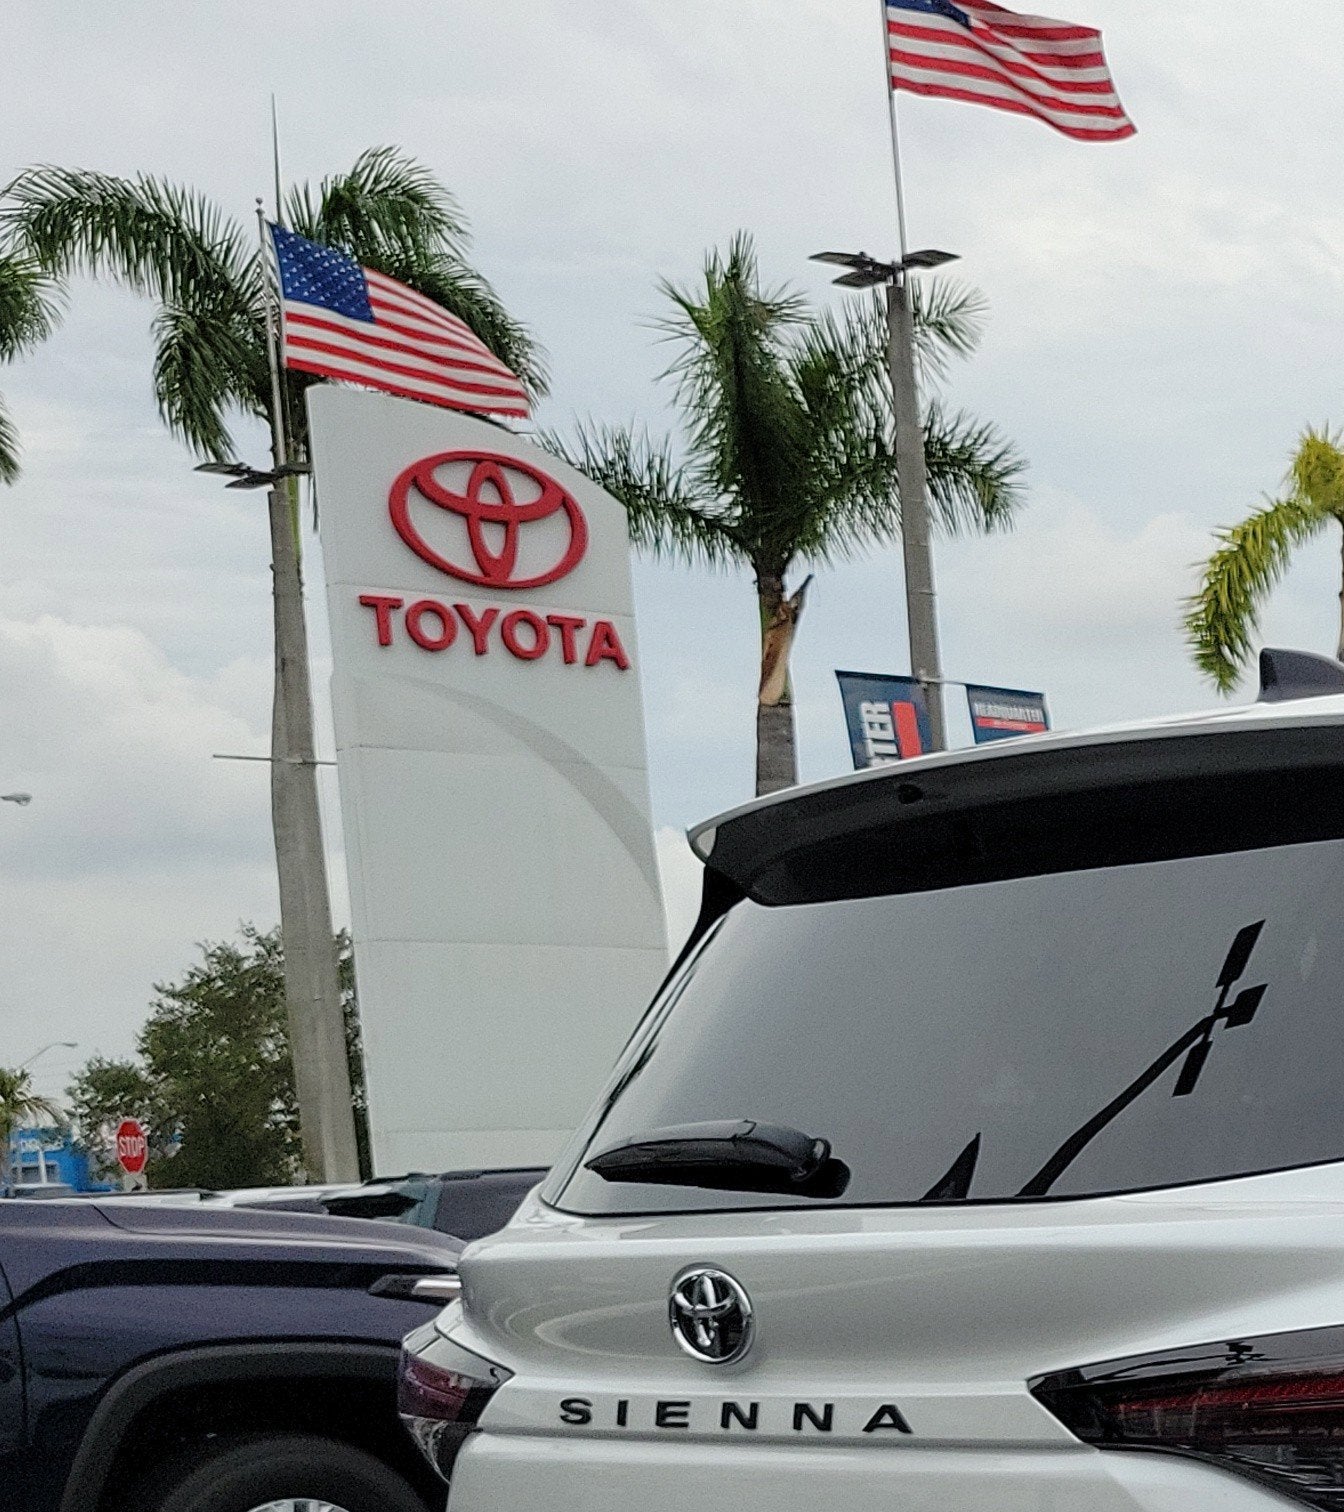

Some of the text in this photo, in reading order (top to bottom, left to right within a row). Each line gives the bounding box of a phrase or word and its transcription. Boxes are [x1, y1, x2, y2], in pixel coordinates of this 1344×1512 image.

[358, 595, 630, 671] TOYOTA
[119, 1135, 145, 1157] STOP
[559, 1398, 914, 1435] SIENNA
